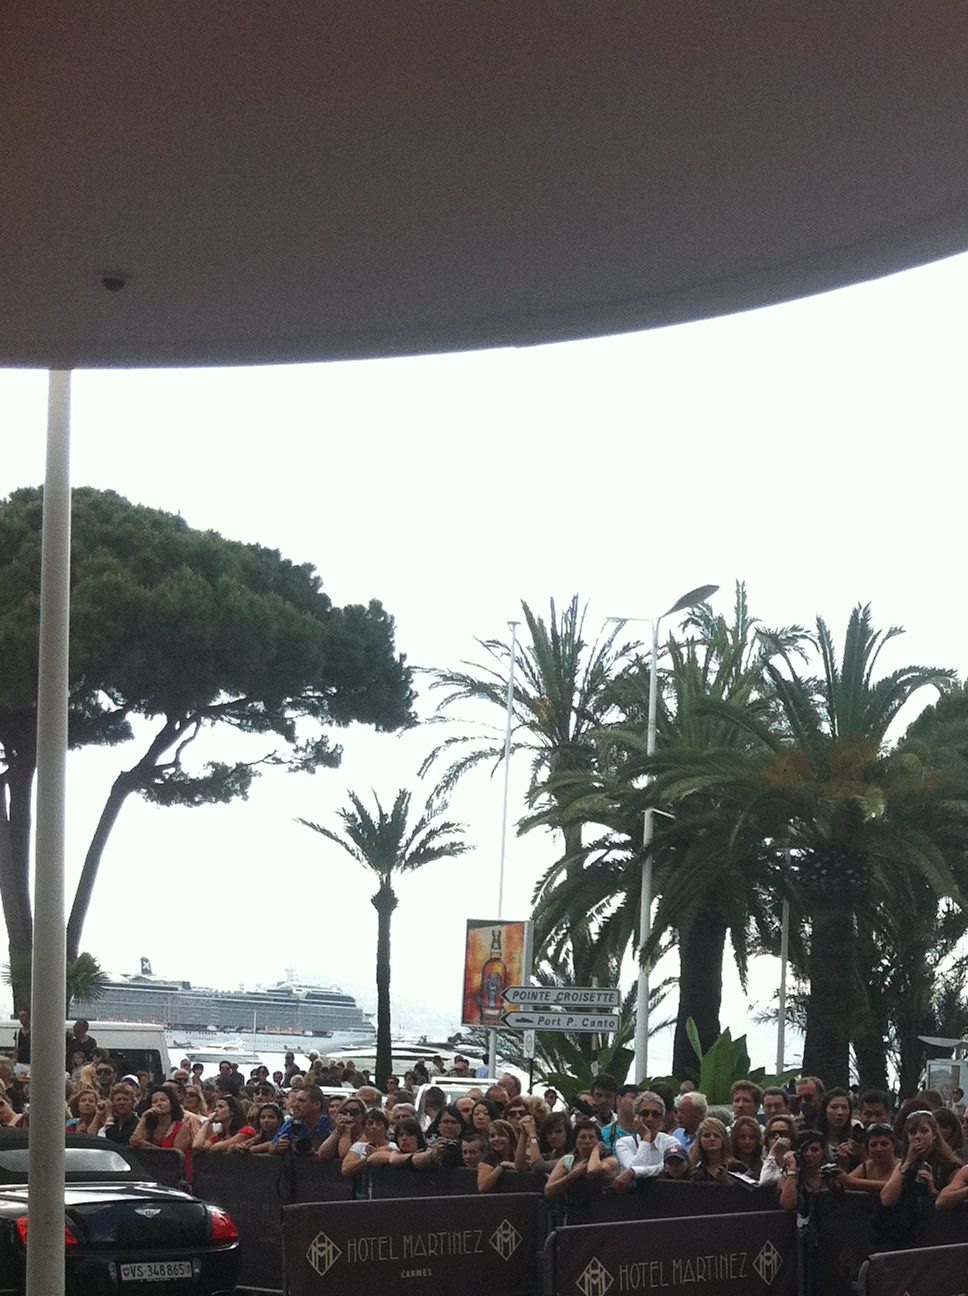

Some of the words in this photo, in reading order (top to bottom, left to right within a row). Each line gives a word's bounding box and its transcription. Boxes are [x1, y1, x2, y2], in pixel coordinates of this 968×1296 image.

[512, 991, 550, 1001] POINTE
[556, 992, 616, 1003] CROISETTE
[537, 1016, 561, 1026] Port
[566, 1017, 578, 1027] P.
[581, 1017, 616, 1029] Canto
[347, 1235, 399, 1264] HOTEL
[403, 1229, 485, 1259] MARTINEZ
[130, 1266, 144, 1277] VS
[400, 1268, 432, 1278] CANNES
[619, 1260, 669, 1291] HOTEL
[672, 1252, 748, 1285] MARTINEZ
